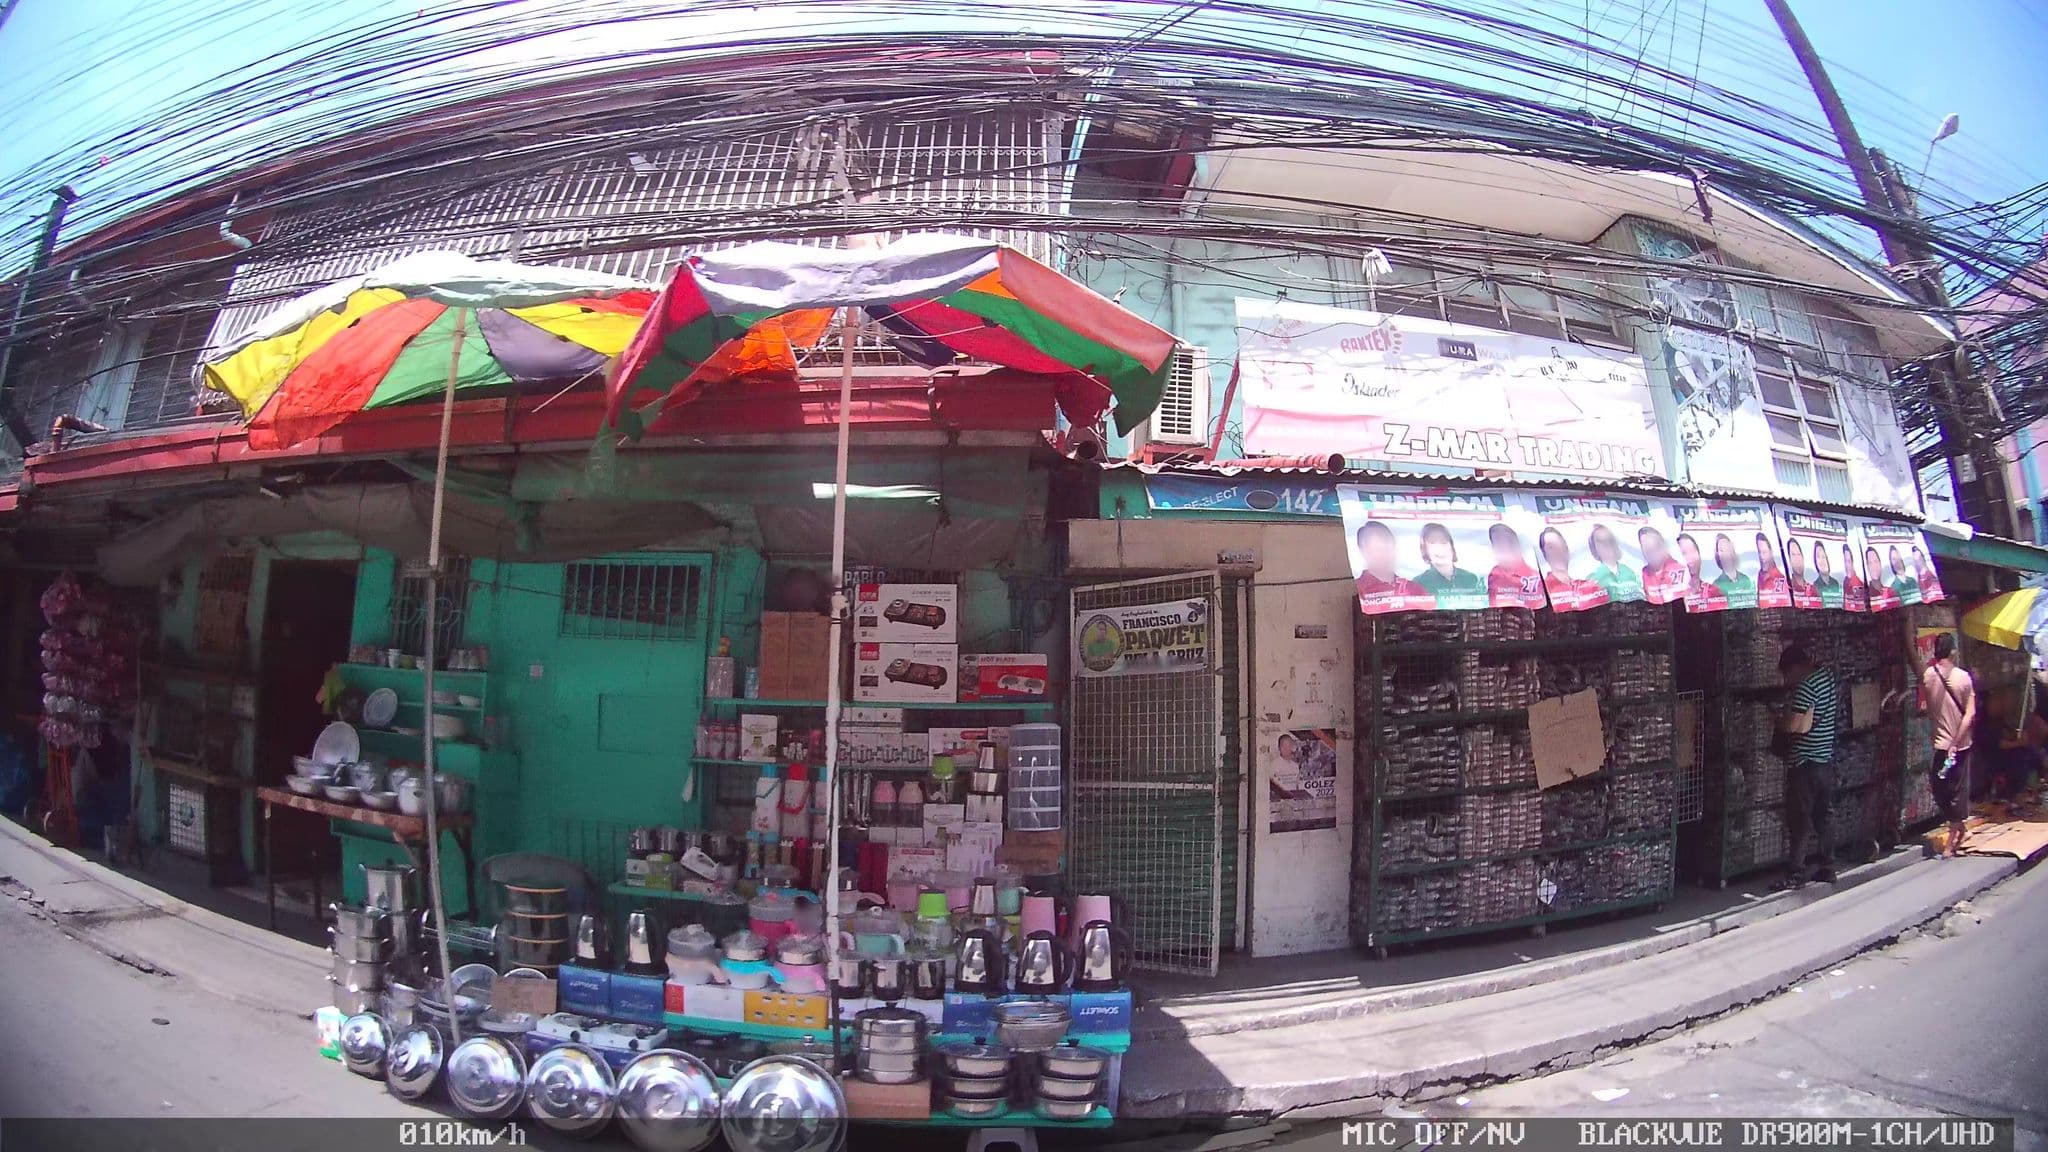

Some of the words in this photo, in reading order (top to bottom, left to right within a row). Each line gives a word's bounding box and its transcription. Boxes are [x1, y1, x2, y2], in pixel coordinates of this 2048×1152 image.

[1383, 423, 1512, 463] Z-MAR
[1518, 436, 1656, 476] TRADING
[1281, 488, 1327, 513] 142
[1520, 576, 1539, 594] 27
[1670, 570, 1685, 586] 27
[1123, 613, 1181, 630] FRANCISCO
[1125, 624, 1205, 650] PAQUET
[1304, 780, 1336, 789] GOLEZ
[1317, 788, 1335, 796] 2022
